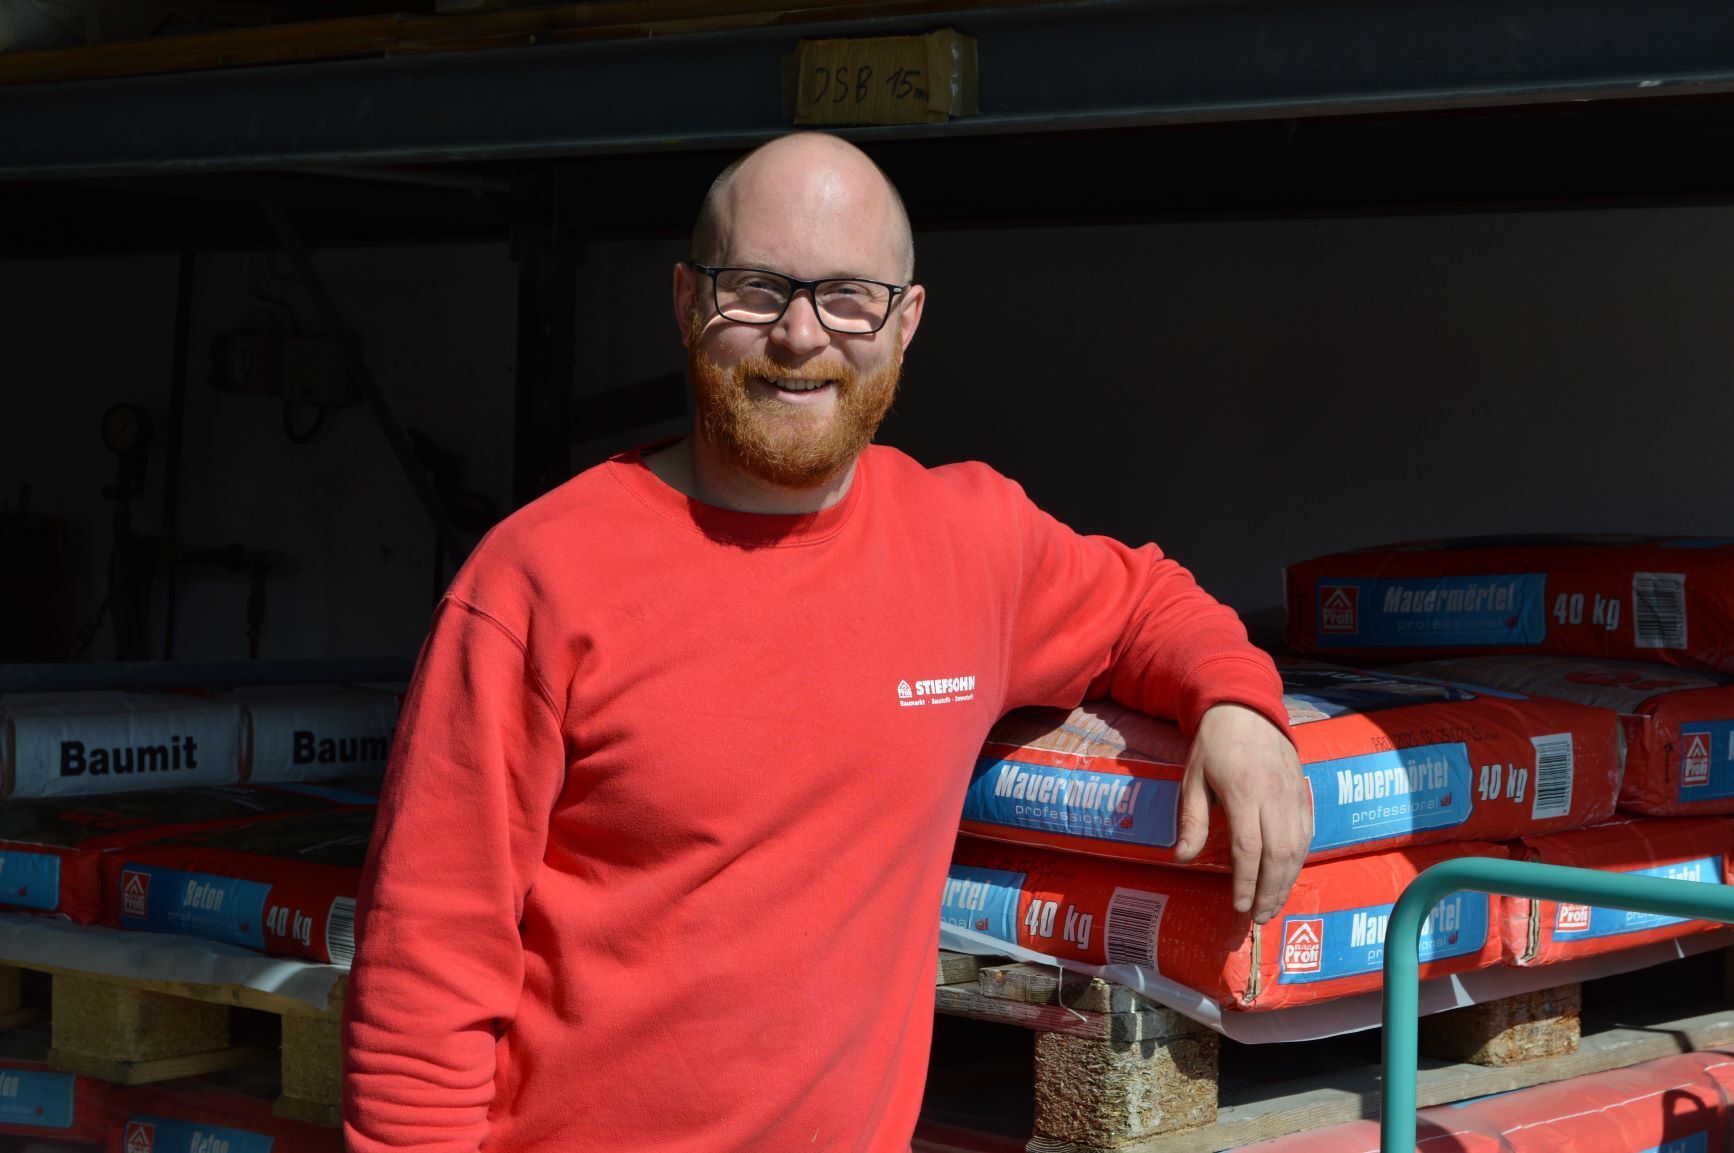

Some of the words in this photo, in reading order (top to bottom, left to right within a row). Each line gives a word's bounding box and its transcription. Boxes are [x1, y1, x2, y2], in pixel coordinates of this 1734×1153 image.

[1383, 583, 1516, 613] Mauermörtel
[1553, 593, 1584, 624] 40
[1592, 593, 1621, 630] kg
[915, 676, 976, 696] STIEFSOHN
[60, 736, 198, 776] Baumit
[293, 728, 395, 764] Baum
[994, 764, 1142, 815] Mauermörtel
[1337, 756, 1449, 806] Mauermörtel
[1477, 764, 1502, 801] 40
[1506, 763, 1528, 803] kg
[1015, 805, 1118, 827] professional
[1352, 796, 1439, 825] professional
[183, 880, 225, 912] Beton
[1559, 905, 1588, 923] Profi
[266, 905, 289, 936] 40
[292, 910, 313, 947] kg
[1025, 899, 1058, 938] 40
[1063, 904, 1093, 950] kg
[1285, 944, 1319, 963] Profi
